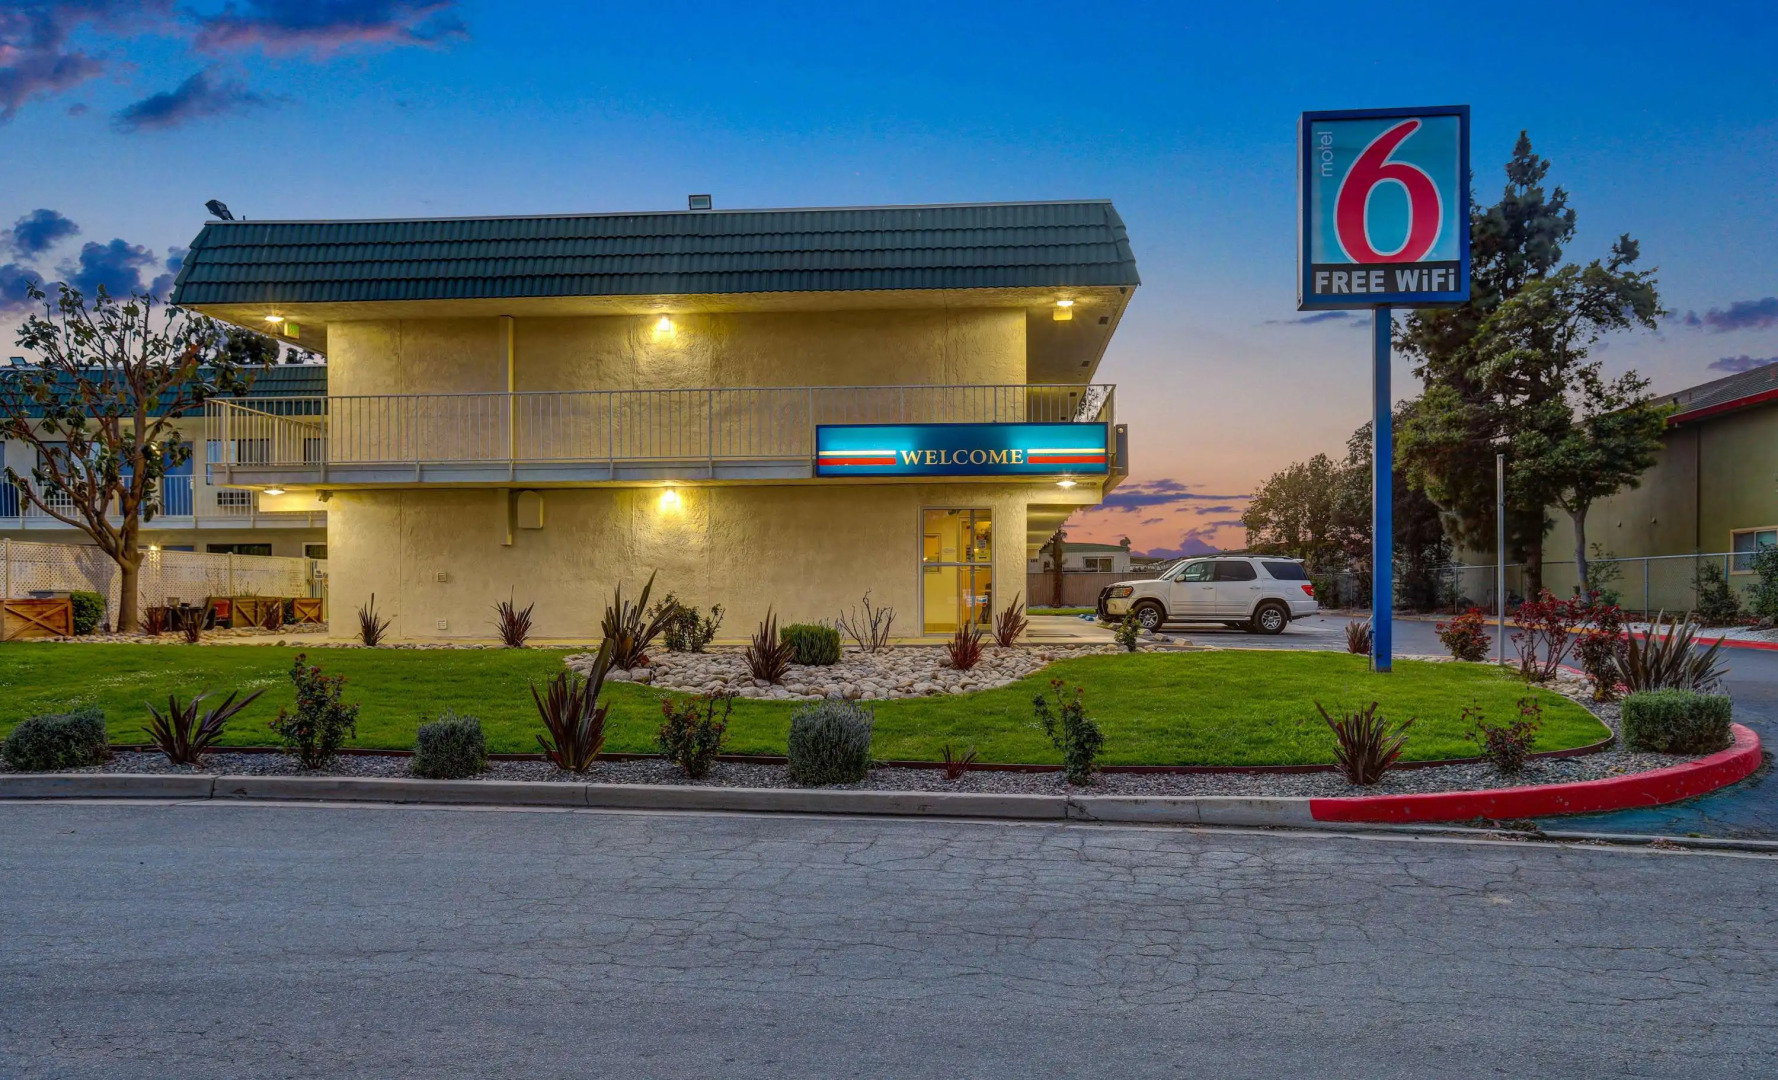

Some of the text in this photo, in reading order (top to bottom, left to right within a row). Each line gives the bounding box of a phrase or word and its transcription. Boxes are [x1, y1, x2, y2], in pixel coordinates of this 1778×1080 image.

[1317, 131, 1334, 177] motel
[1333, 118, 1443, 263] 6
[1315, 268, 1455, 294] FREE WiFi
[901, 449, 1024, 465] WELCOME
